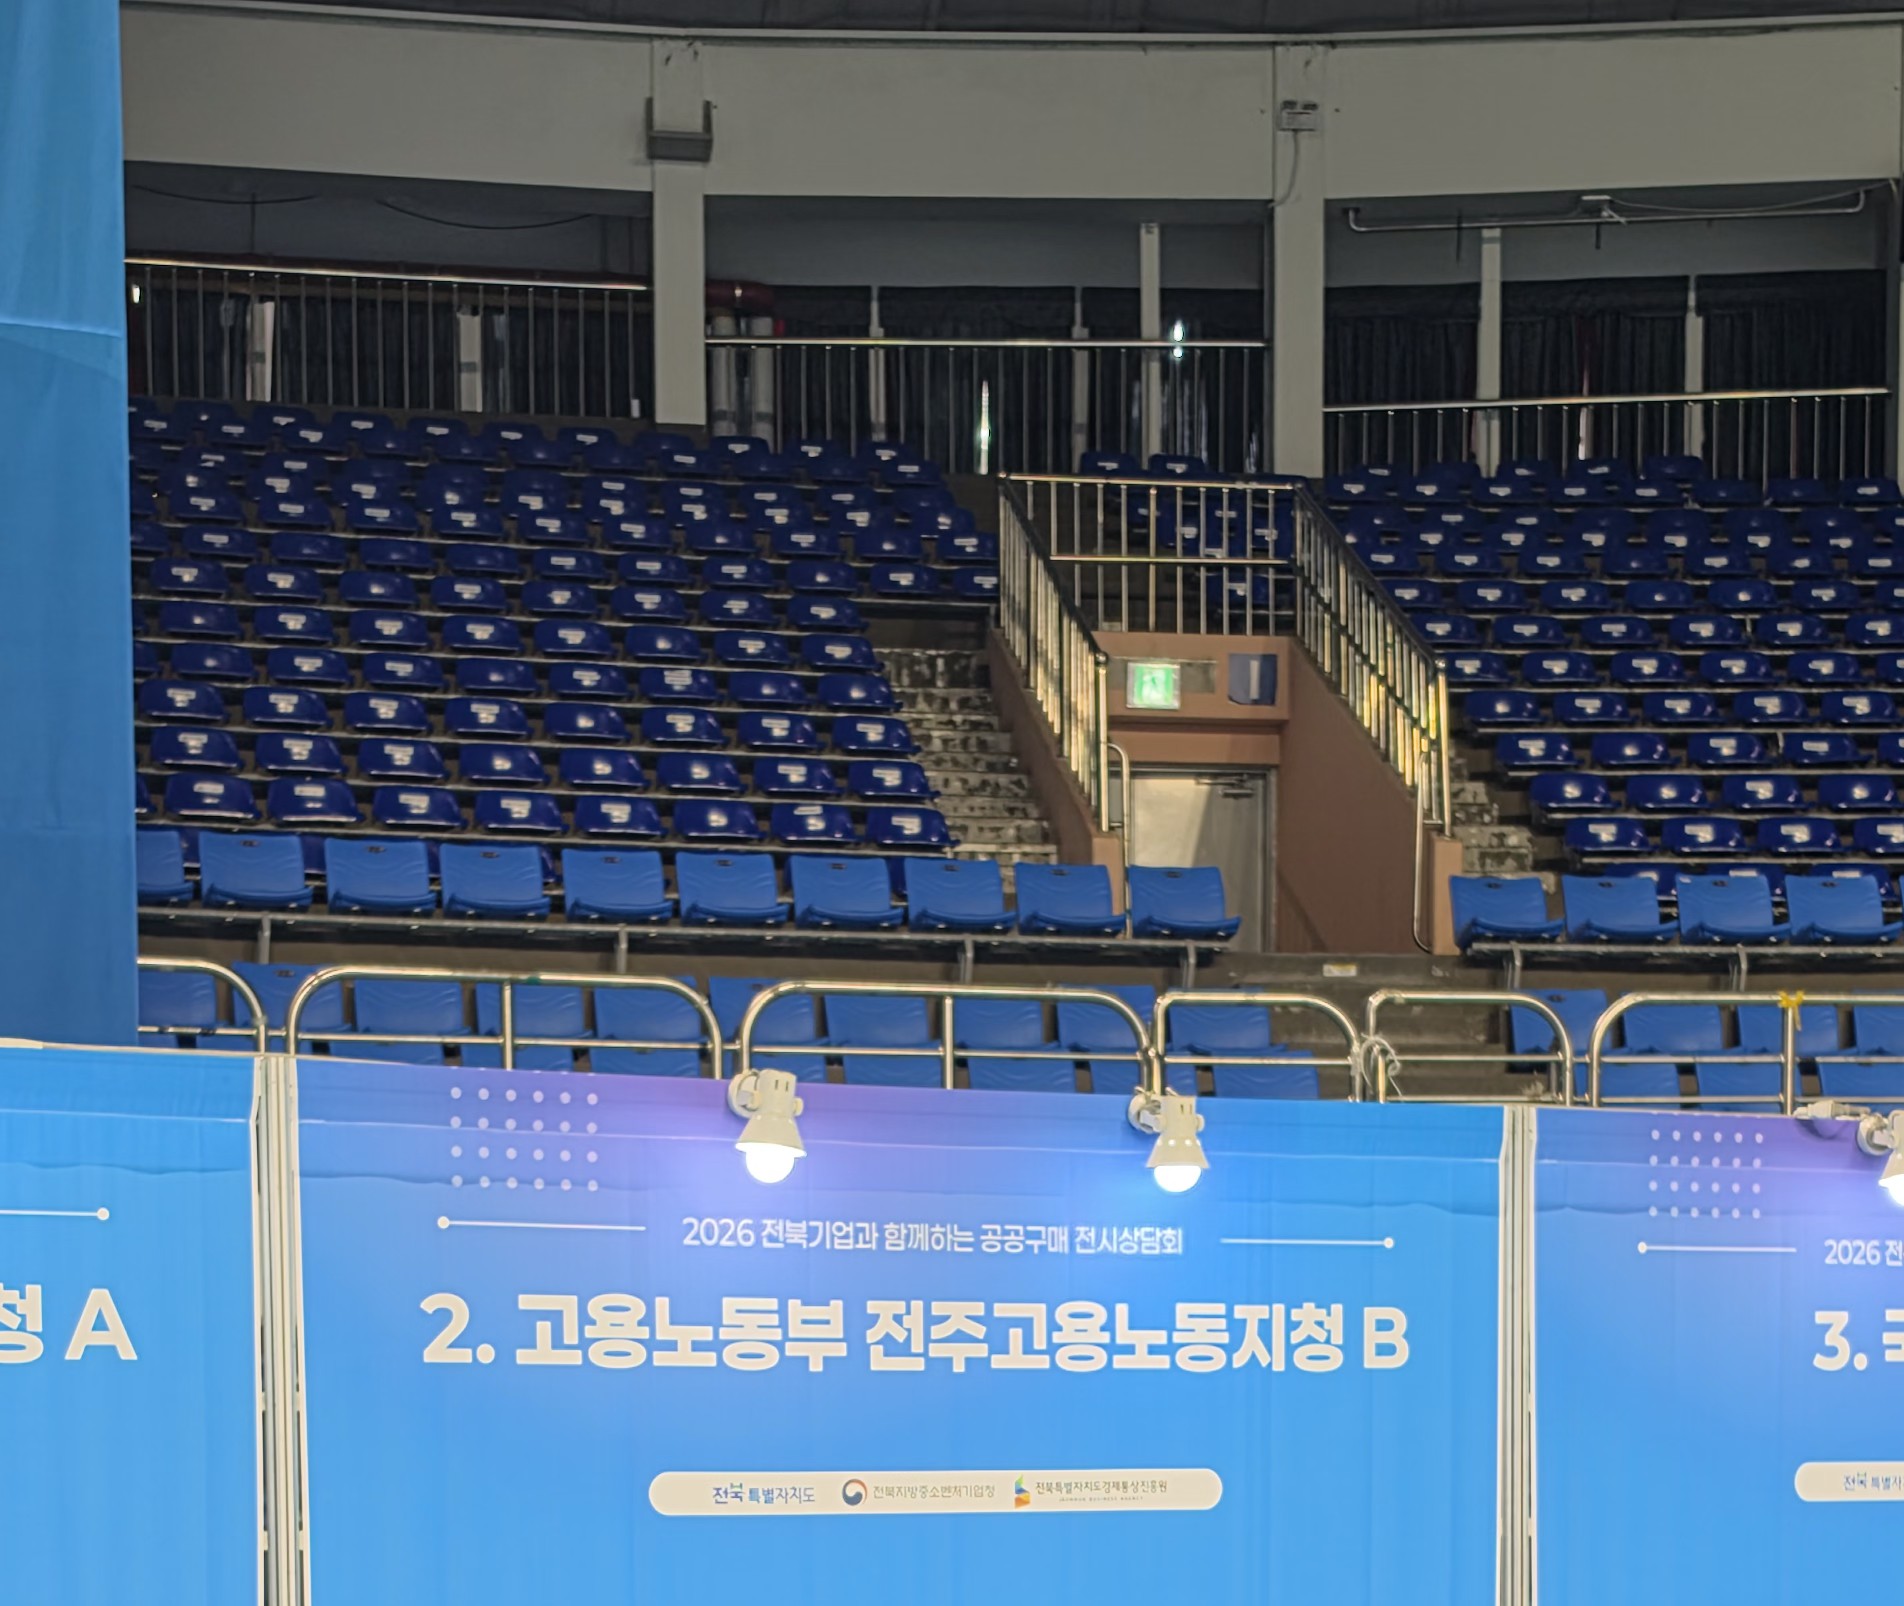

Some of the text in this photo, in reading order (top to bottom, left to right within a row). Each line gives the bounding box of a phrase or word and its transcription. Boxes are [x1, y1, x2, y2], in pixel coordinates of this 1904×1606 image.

[681, 1217, 1183, 1256] 2026 전북기업과 함께하는 공공구매 전시상담회
[1824, 1239, 1881, 1266] 2026
[63, 1287, 139, 1362] A
[419, 1293, 1411, 1373] 2. 고용노동부 전주고용노동지청 B
[1812, 1310, 1868, 1371] 3.
[748, 1486, 816, 1504] 특별자치도
